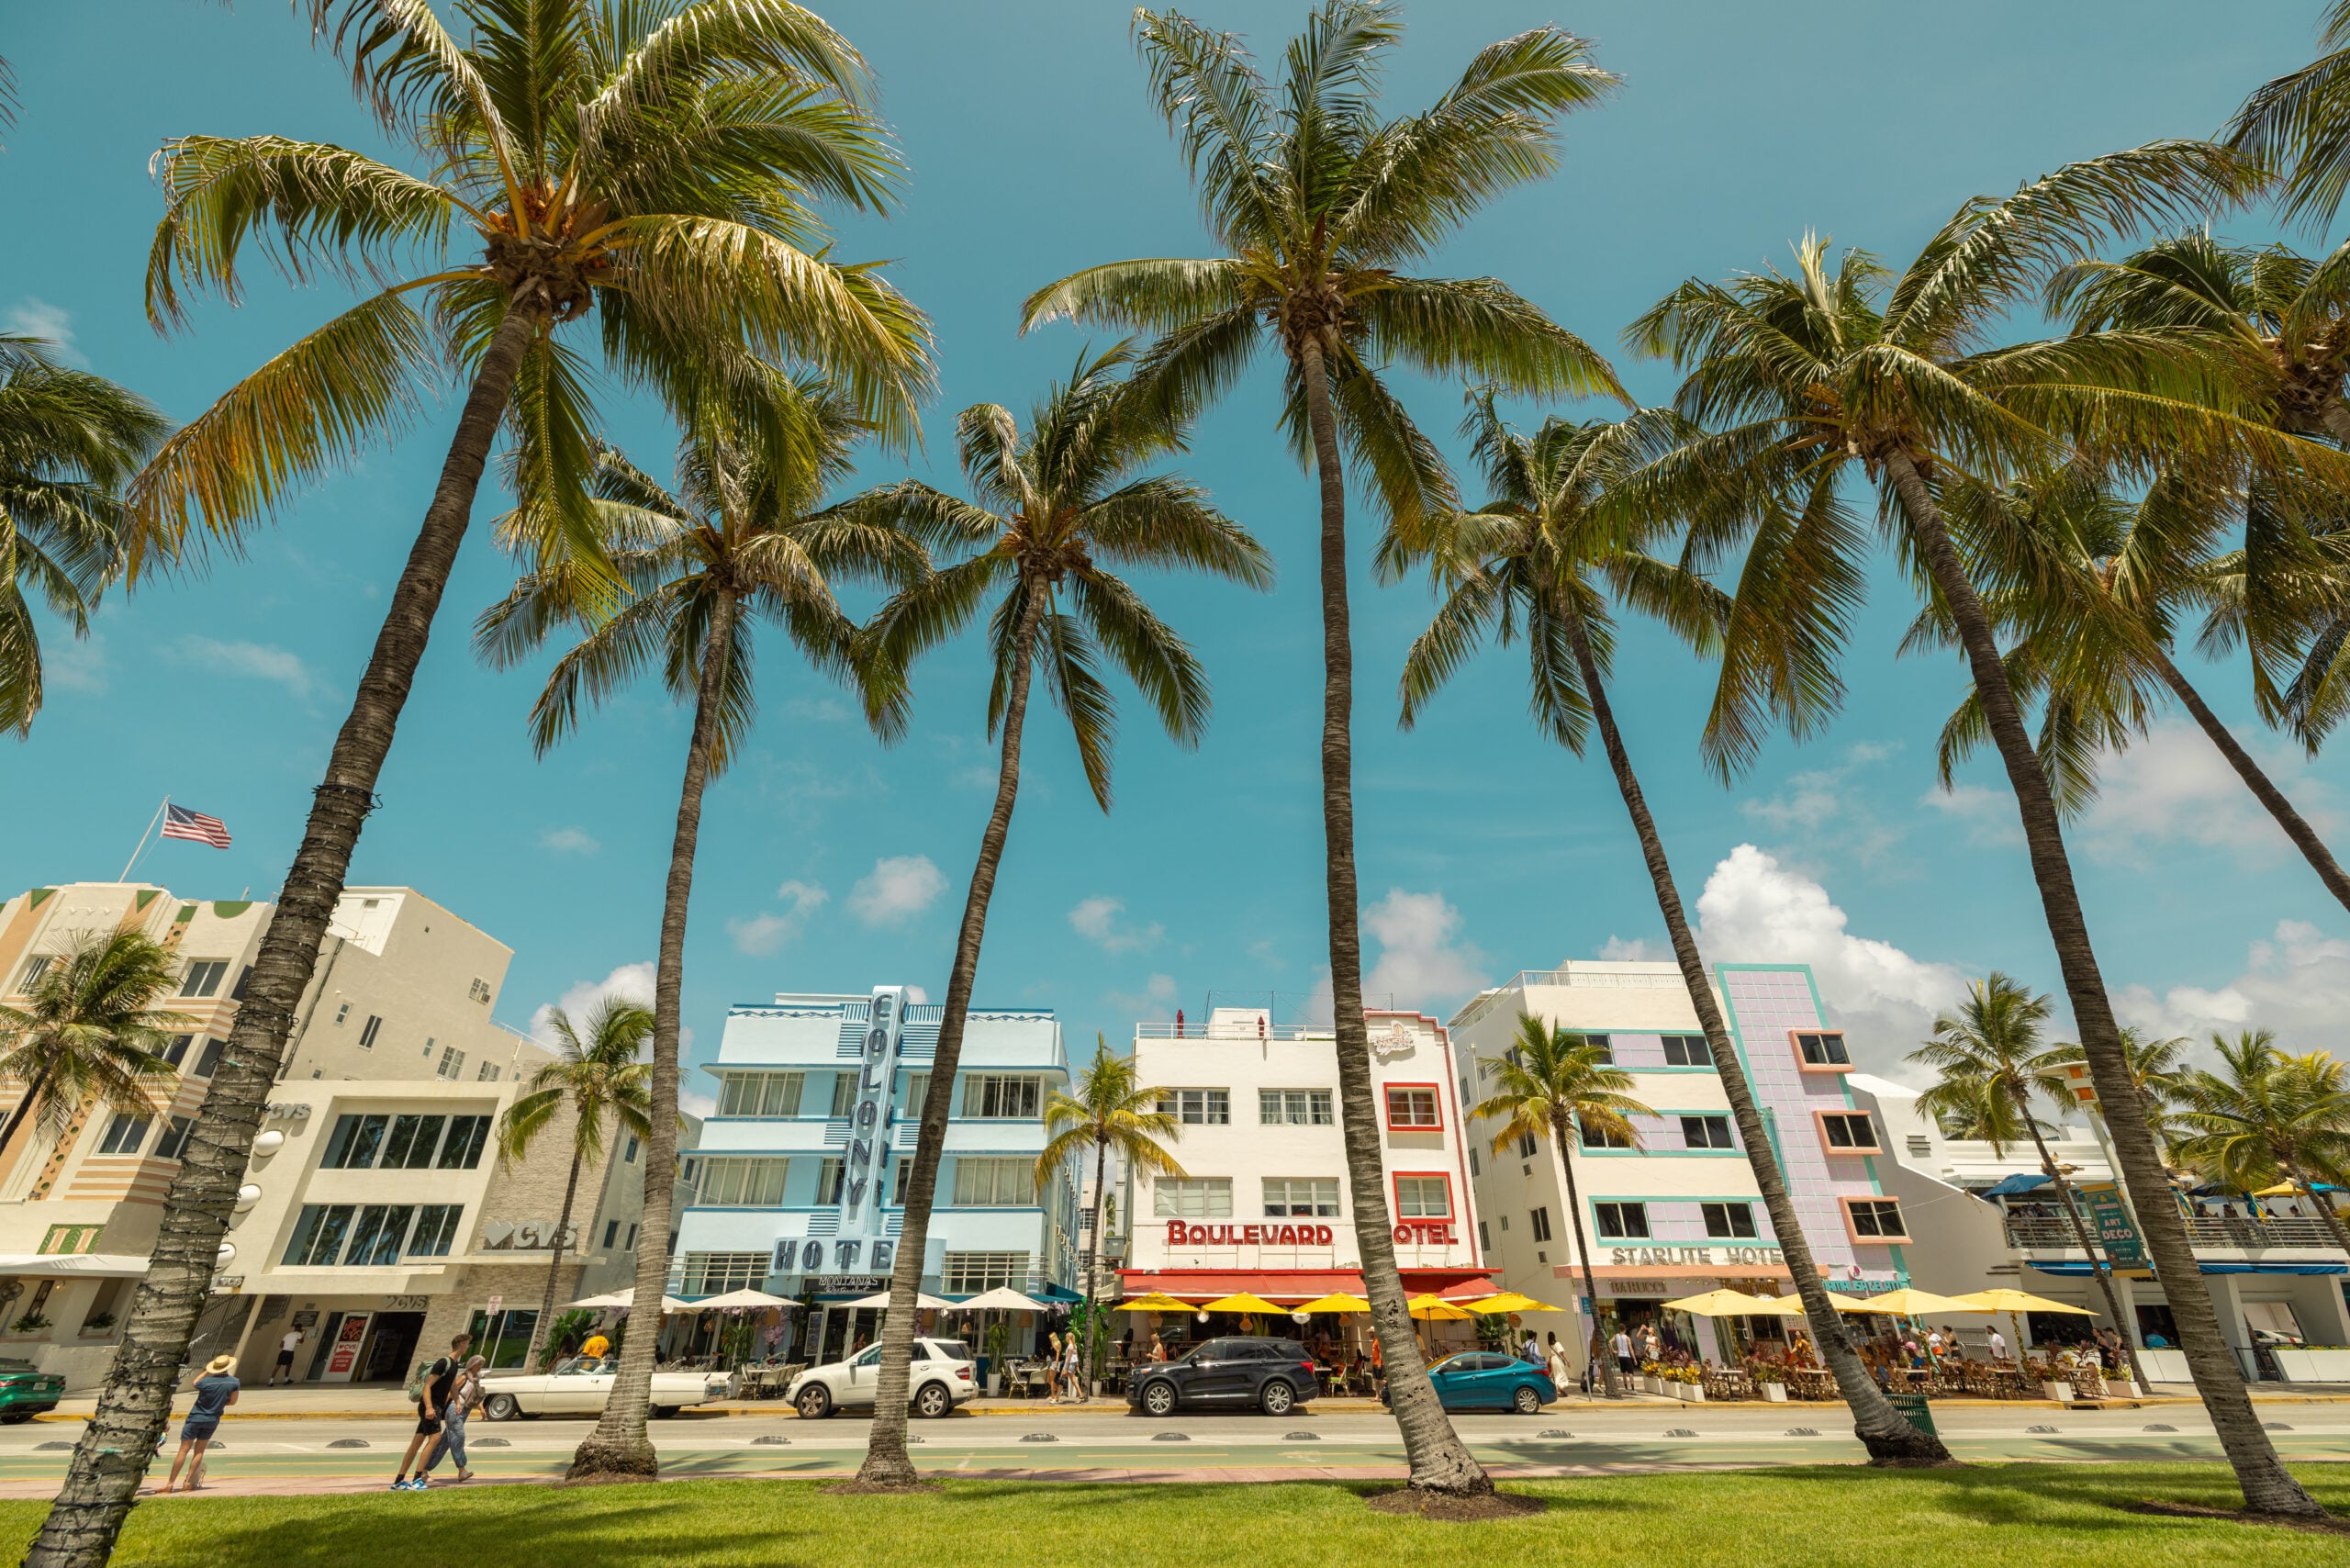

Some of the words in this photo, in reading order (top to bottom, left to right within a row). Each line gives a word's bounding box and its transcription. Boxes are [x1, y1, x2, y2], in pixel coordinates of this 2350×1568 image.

[847, 994, 892, 1205] COLONY
[268, 1103, 311, 1120] CVS
[2104, 1218, 2121, 1227] ART
[513, 1221, 579, 1248] CVS
[1166, 1219, 1333, 1246] BOULEVARD
[1393, 1224, 1459, 1245] OTEL
[2101, 1228, 2133, 1240] DECO
[774, 1239, 894, 1271] HOTE
[1612, 1247, 1713, 1266] STARLITE
[1726, 1247, 1785, 1266] HOTE
[819, 1275, 878, 1286] MONTANA'S
[824, 1285, 871, 1295] Restaurant
[397, 1295, 428, 1309] CVS
